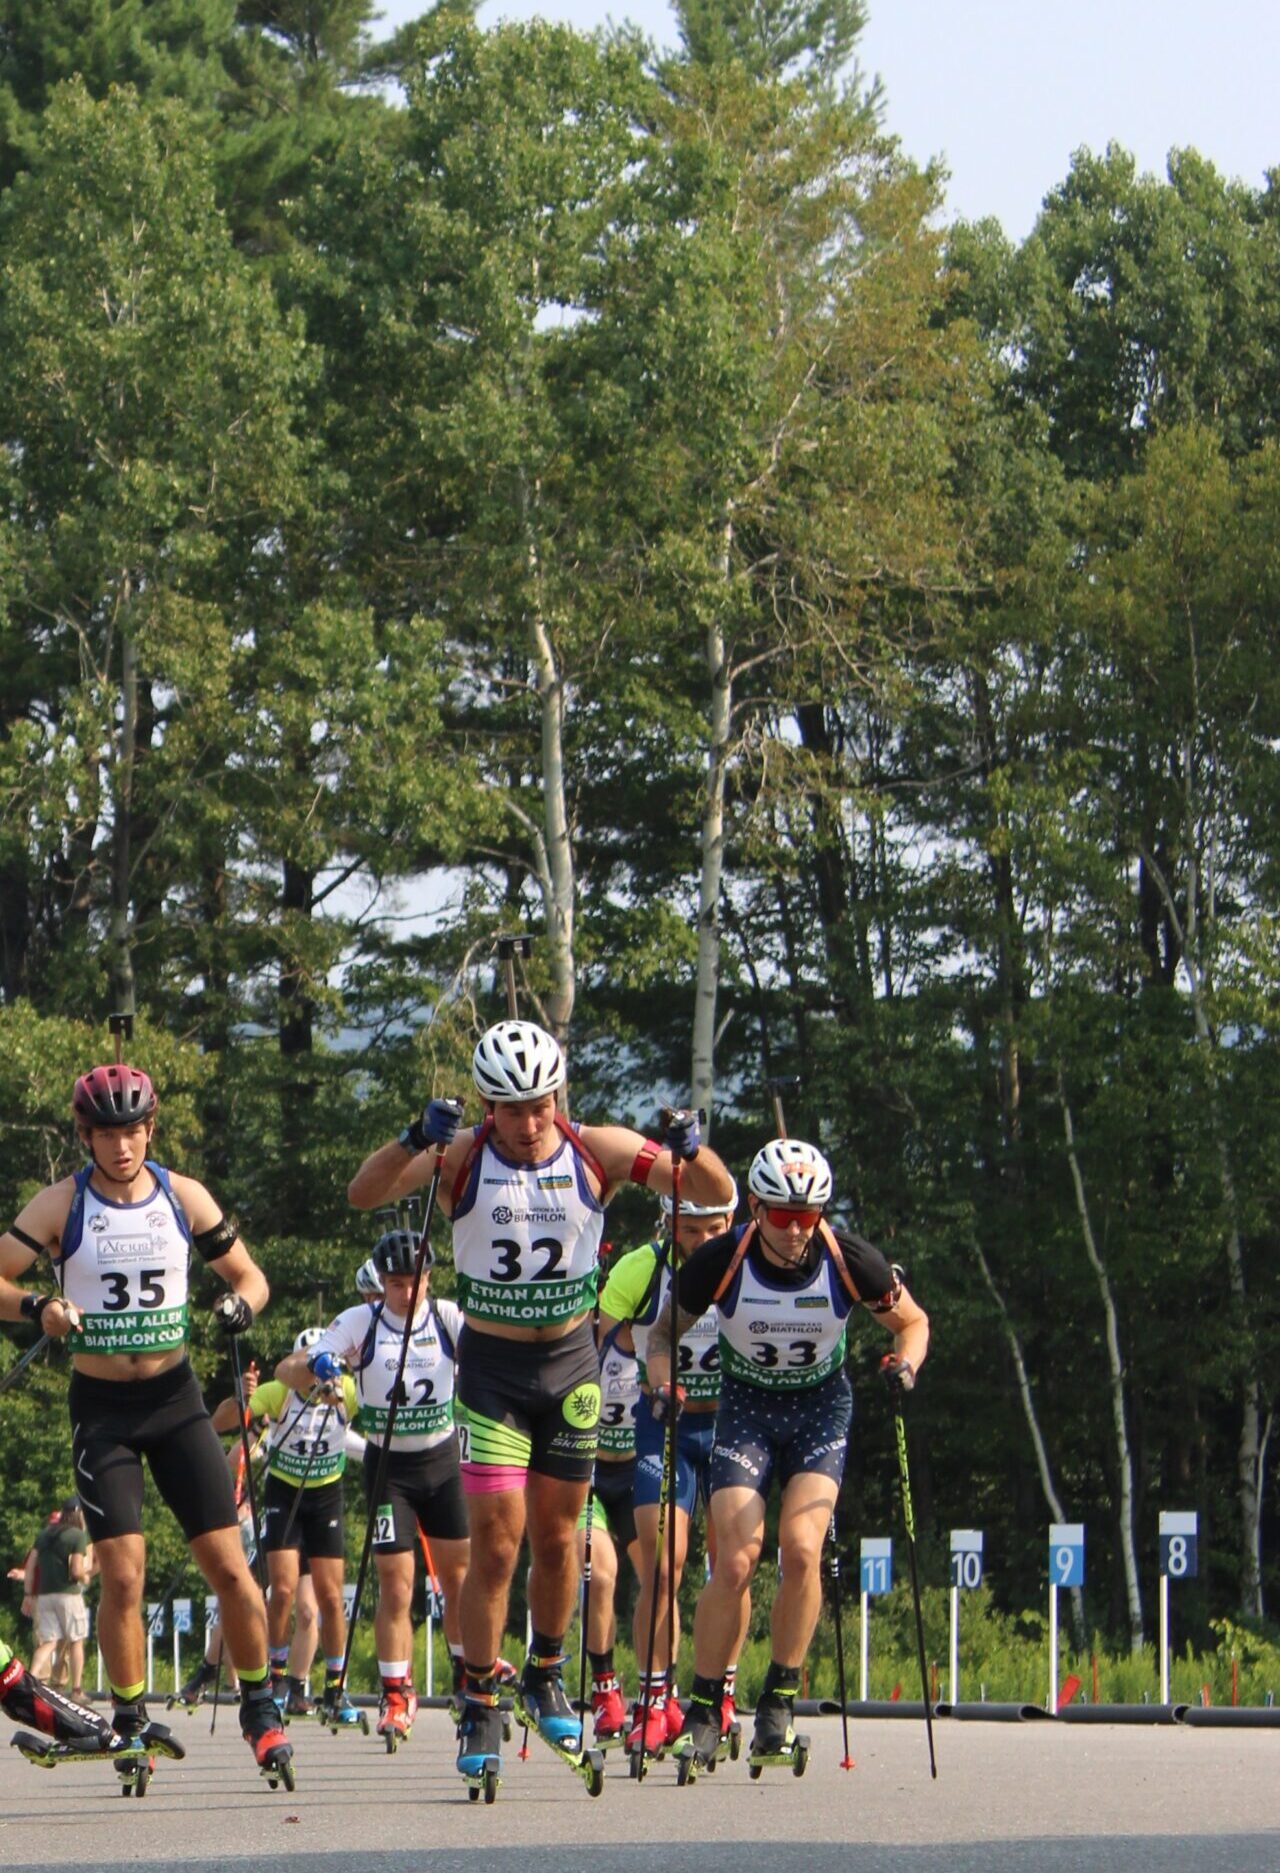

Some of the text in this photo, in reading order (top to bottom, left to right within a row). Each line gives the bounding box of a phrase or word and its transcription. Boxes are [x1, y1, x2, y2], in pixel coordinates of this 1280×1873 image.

[514, 1212, 566, 1222] BIATHLON
[490, 1237, 567, 1282] 32
[101, 1269, 165, 1311] 35
[471, 1281, 585, 1300] ETHAN ALLEN
[467, 1296, 547, 1319] BIATHLON
[86, 1310, 182, 1330] ETHAN ALLEN
[84, 1332, 155, 1347] BIATHLON
[751, 1341, 817, 1367] 33
[385, 1378, 437, 1406] 42
[376, 1405, 448, 1420] ETAN ALLEN
[600, 1403, 636, 1426] 3
[1056, 1547, 1074, 1584] 9
[1168, 1535, 1187, 1576] 8
[863, 1558, 887, 1591] 11
[952, 1551, 982, 1588] 10
[174, 1610, 191, 1631] 25
